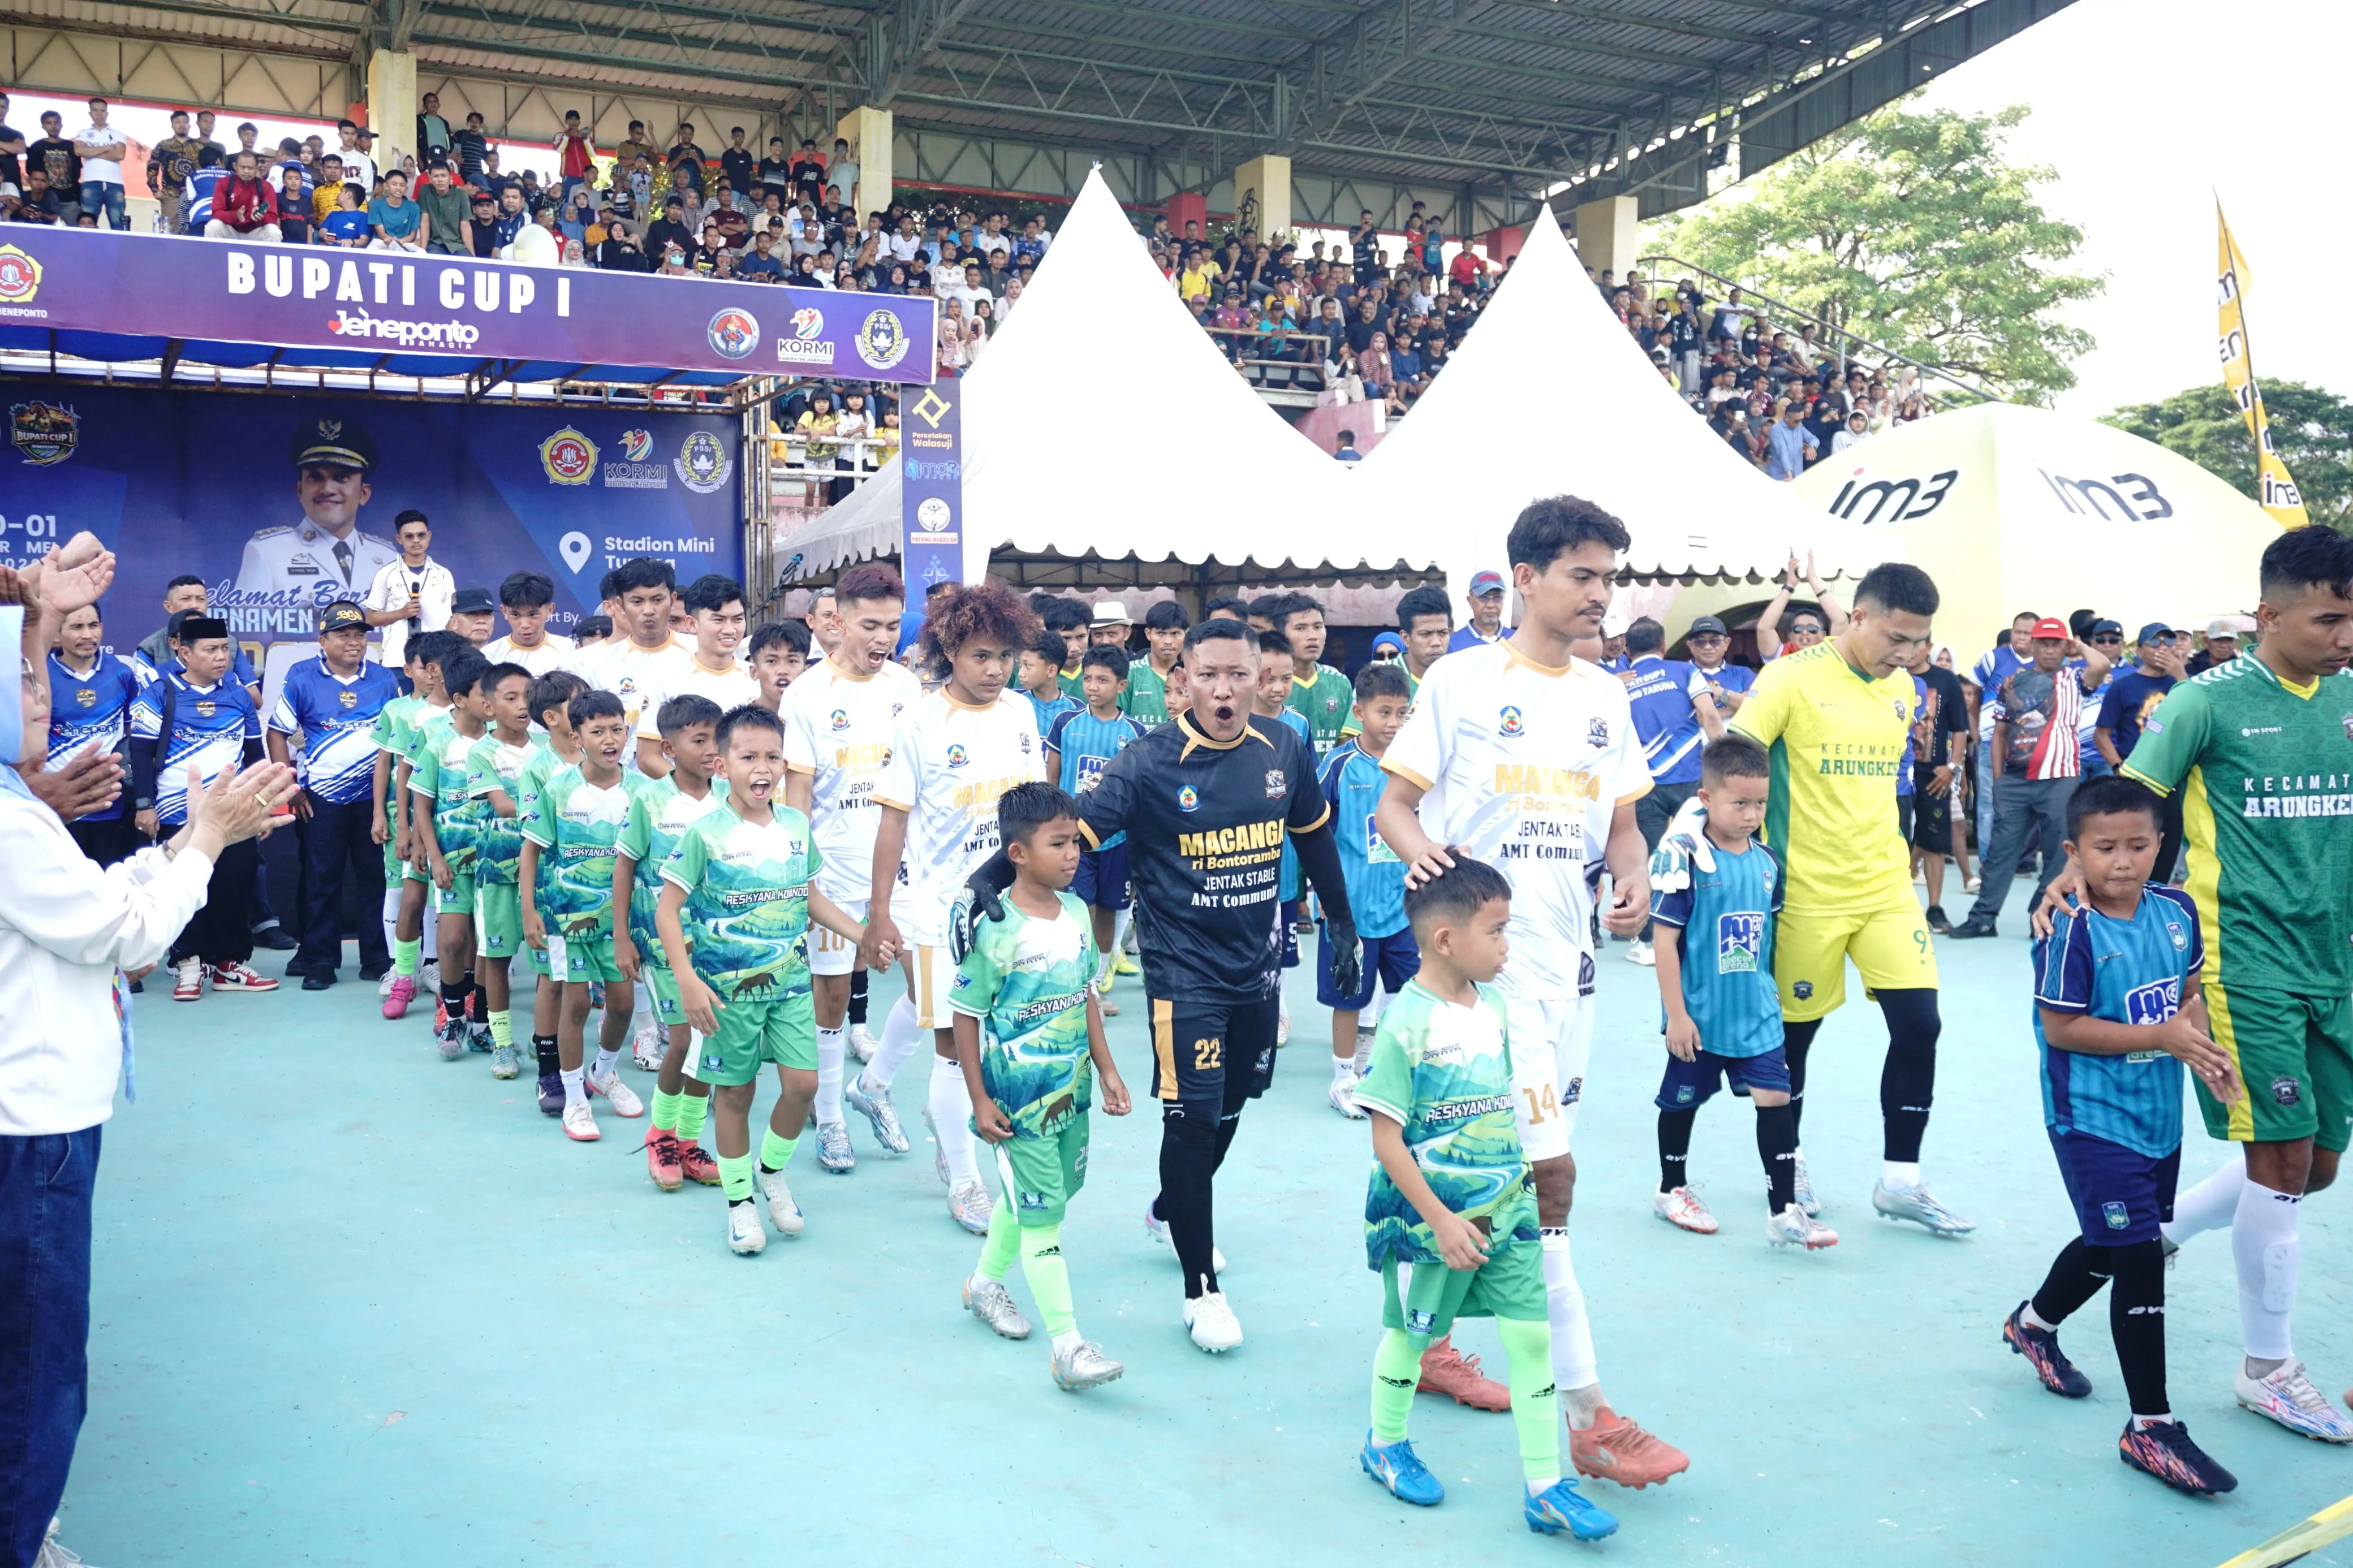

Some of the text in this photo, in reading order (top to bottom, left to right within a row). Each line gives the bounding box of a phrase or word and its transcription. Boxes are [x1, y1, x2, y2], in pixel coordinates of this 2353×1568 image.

[228, 252, 570, 317] BUPATI CUP I
[409, 340, 472, 349] BAHAGIA
[778, 340, 833, 356] KORMI
[16, 431, 48, 441] BUPATI
[49, 433, 67, 442] CUP
[912, 439, 953, 450] Walasuji
[604, 463, 667, 480] KORMI
[26, 541, 55, 553] ME
[604, 536, 714, 552] Stadion Mini
[202, 579, 301, 607] elamat
[1643, 681, 1678, 697] TARUNA
[2244, 774, 2350, 792] KECAMAT
[838, 798, 859, 810] AMT
[2243, 794, 2353, 818] ARUNGKE
[975, 820, 999, 836] JENTA
[1518, 820, 1562, 837] JENTAK
[1178, 818, 1285, 857] MACANGA
[564, 848, 605, 858] RESKYANA
[963, 840, 984, 853] AMT
[1500, 843, 1530, 858] AMT
[1192, 848, 1281, 870] ri Bontoramba
[1204, 867, 1275, 891] JENTAK STABLE
[726, 891, 776, 905] RESKYANA
[1191, 892, 1219, 908] AMT
[1288, 923, 1297, 944] 5
[1913, 929, 1929, 954] 9
[1722, 956, 1752, 964] soccer
[1722, 962, 1749, 970] arena
[1018, 996, 1071, 1022] RESKYANA
[1195, 1038, 1221, 1070] 22
[1425, 1098, 1492, 1123] RESKYANA
[1523, 1083, 1558, 1125] 14
